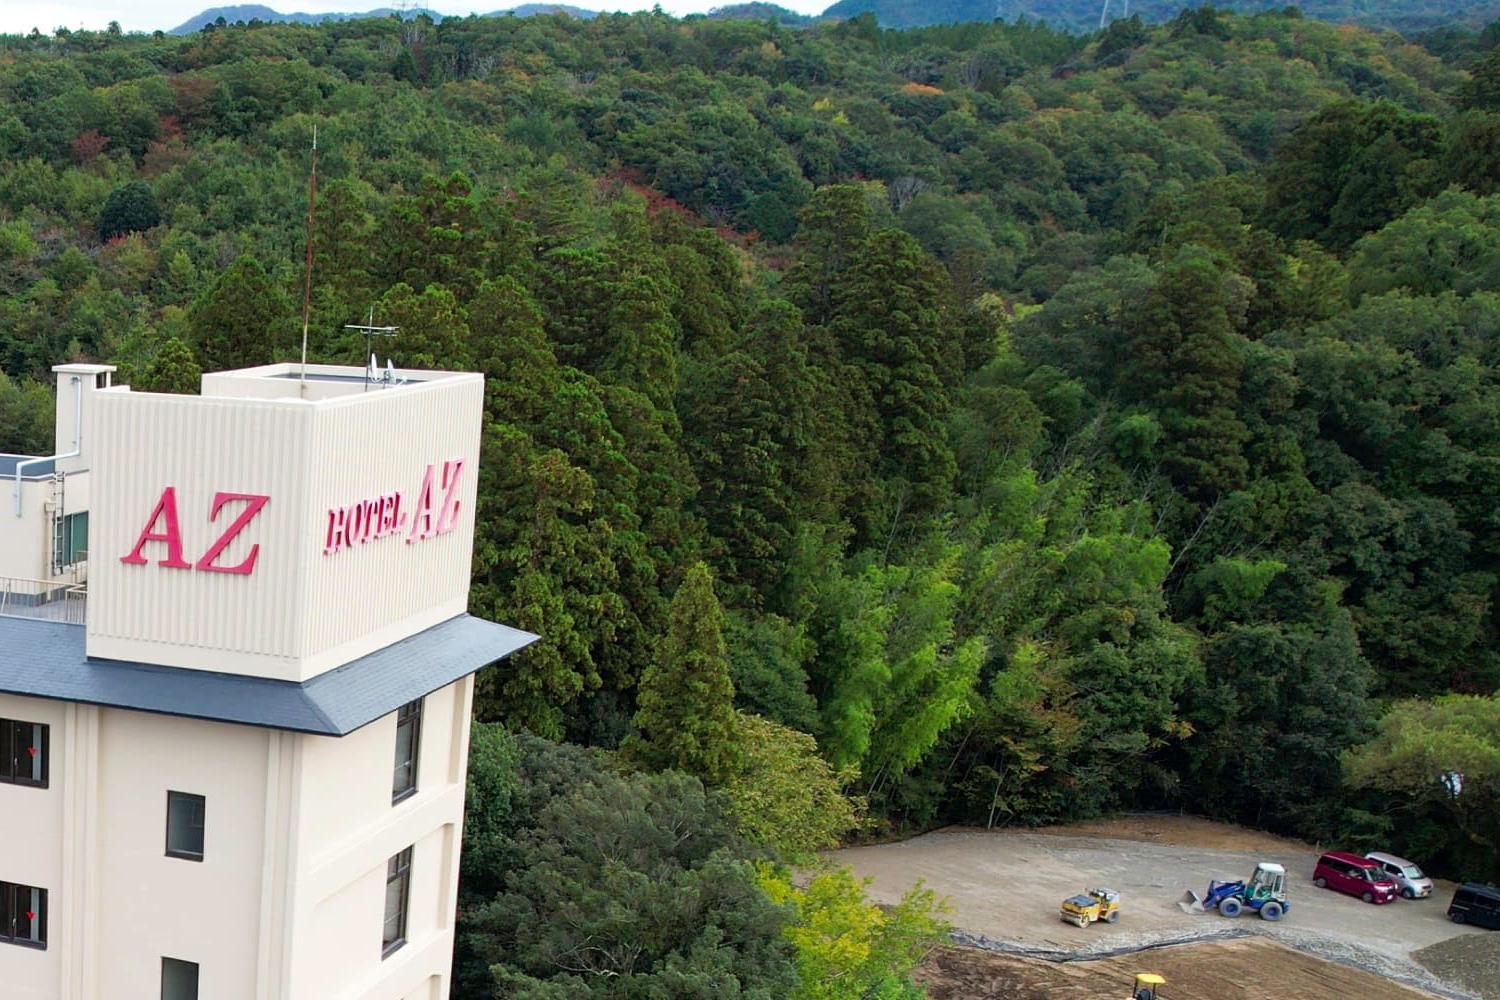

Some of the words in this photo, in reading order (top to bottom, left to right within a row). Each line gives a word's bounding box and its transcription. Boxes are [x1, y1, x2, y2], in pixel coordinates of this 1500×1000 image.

[120, 486, 270, 575] AZ
[323, 491, 407, 556] HOTEL
[406, 457, 466, 545] AZ
